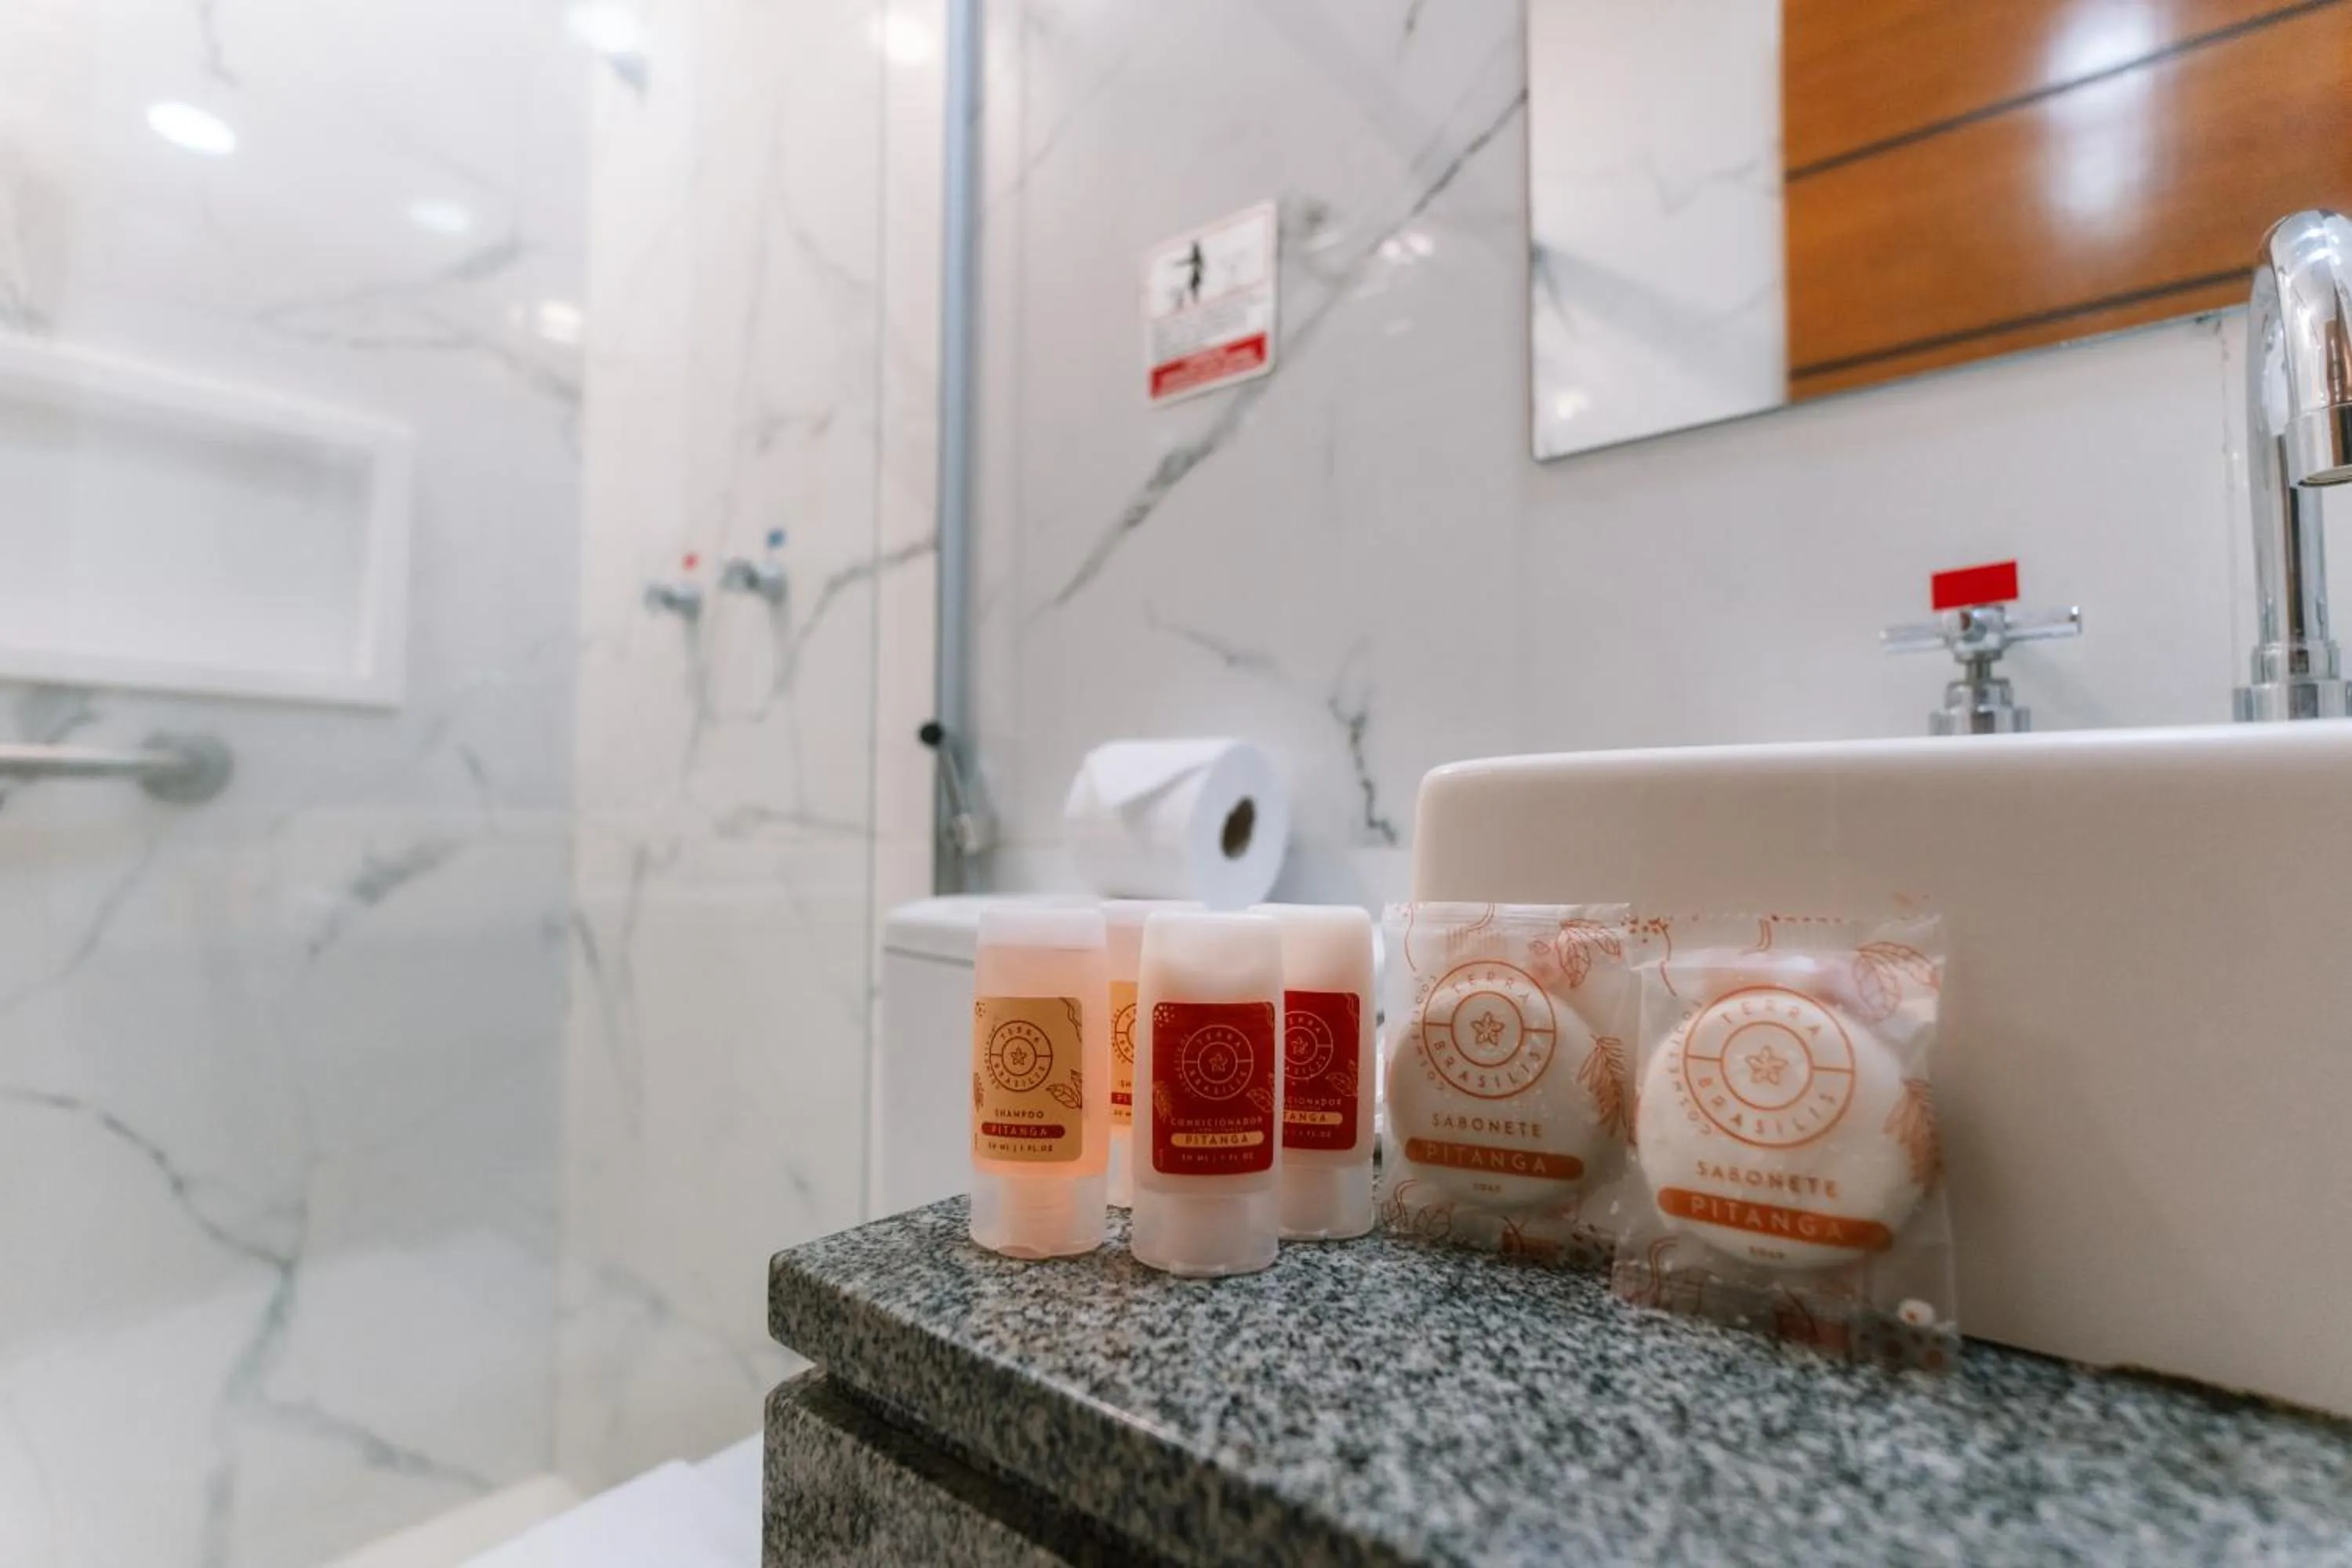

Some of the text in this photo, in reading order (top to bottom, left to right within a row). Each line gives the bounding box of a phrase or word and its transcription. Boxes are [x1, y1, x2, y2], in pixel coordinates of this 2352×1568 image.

[1720, 1000, 1822, 1038] TERRA
[1434, 1040, 1541, 1089] BRASILIS
[994, 1108, 1045, 1120] SHAMPOO
[1283, 1111, 1327, 1122] TANGA
[1697, 1076, 1836, 1134] BRASILIS
[990, 1124, 1047, 1137] PITANGA
[1185, 1134, 1250, 1145] PITANGA
[1431, 1112, 1543, 1139] SABONETE
[1425, 1142, 1548, 1174] PITANGA
[1695, 1159, 1839, 1199] SABONETE
[1690, 1195, 1843, 1241] PITANGA
